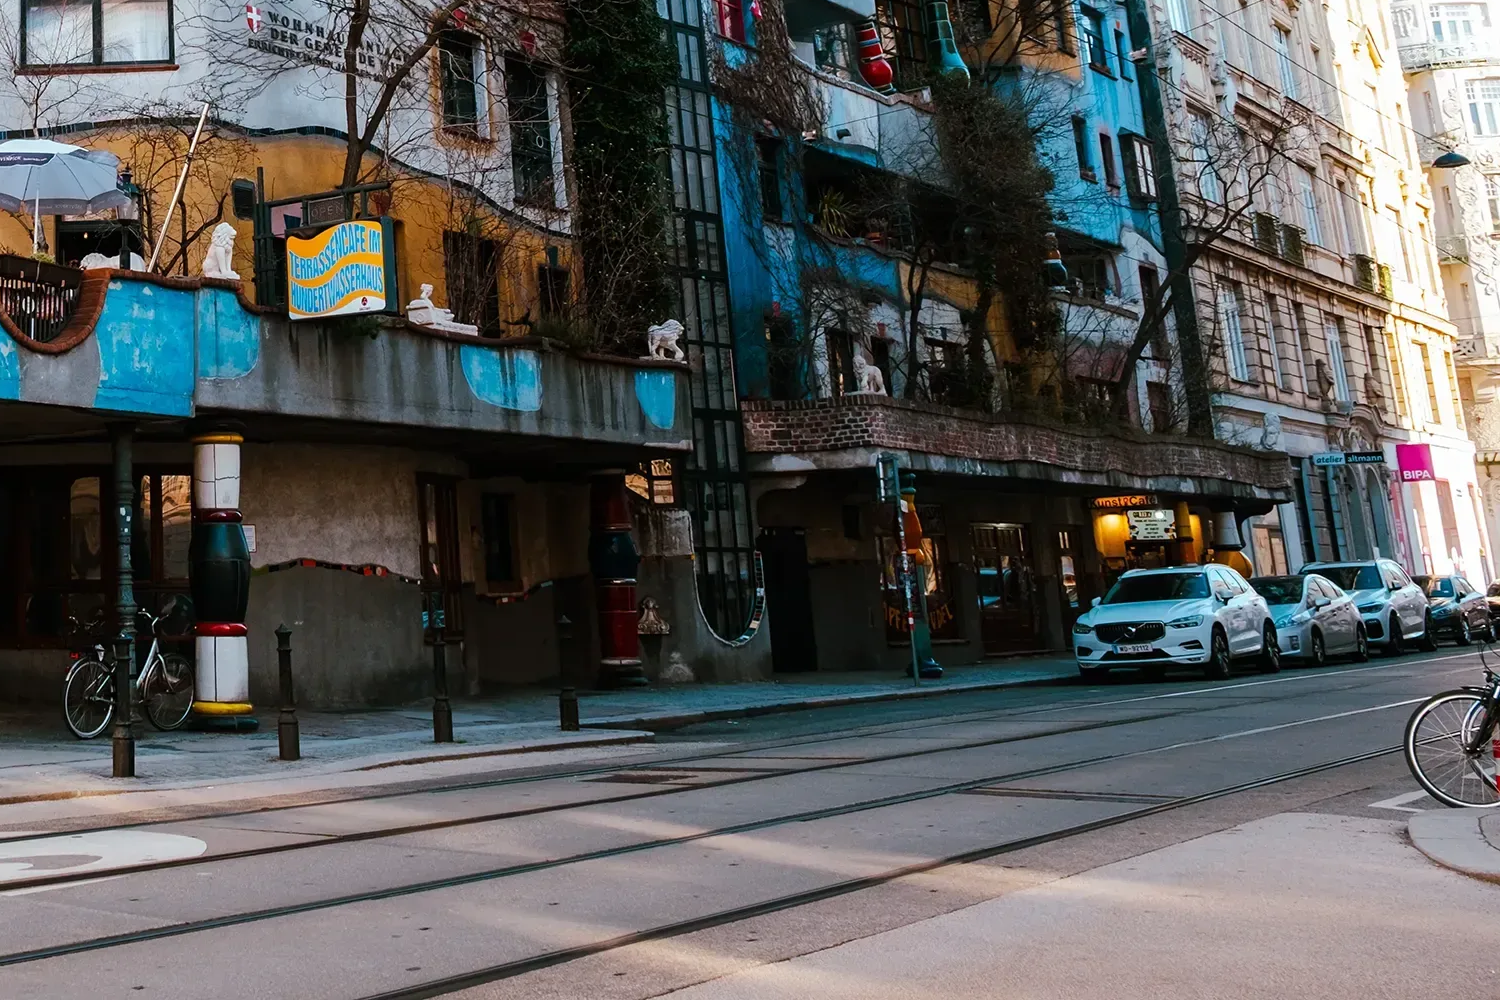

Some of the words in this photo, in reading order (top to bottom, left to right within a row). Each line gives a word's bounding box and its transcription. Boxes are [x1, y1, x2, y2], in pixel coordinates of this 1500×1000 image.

[270, 27, 299, 46] DER
[311, 201, 344, 217] OPEN
[289, 224, 366, 279] TERRASSENCAFE
[369, 229, 380, 253] IM
[291, 264, 383, 313] HUNDERTWASSERHAUS
[1316, 456, 1344, 464] atelier
[1347, 454, 1383, 463] altmann
[1403, 470, 1432, 479] BIPA
